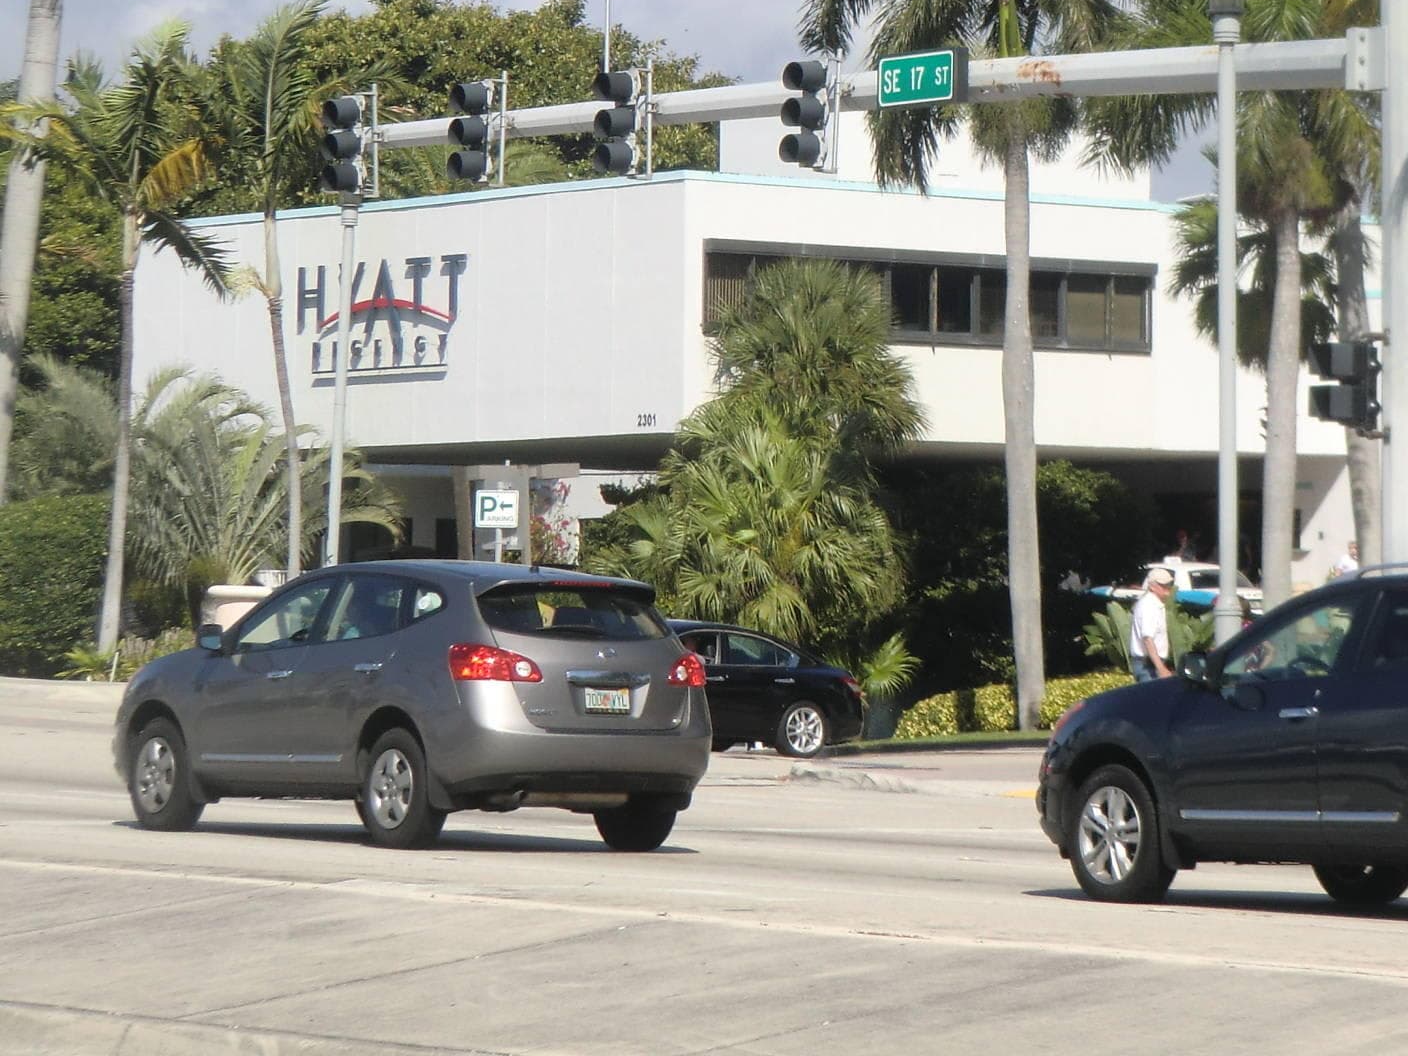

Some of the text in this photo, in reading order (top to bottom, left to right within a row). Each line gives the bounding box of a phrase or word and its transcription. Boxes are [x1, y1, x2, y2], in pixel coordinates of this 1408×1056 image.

[883, 66, 949, 94] SE 17 ST
[637, 414, 657, 427] 2301
